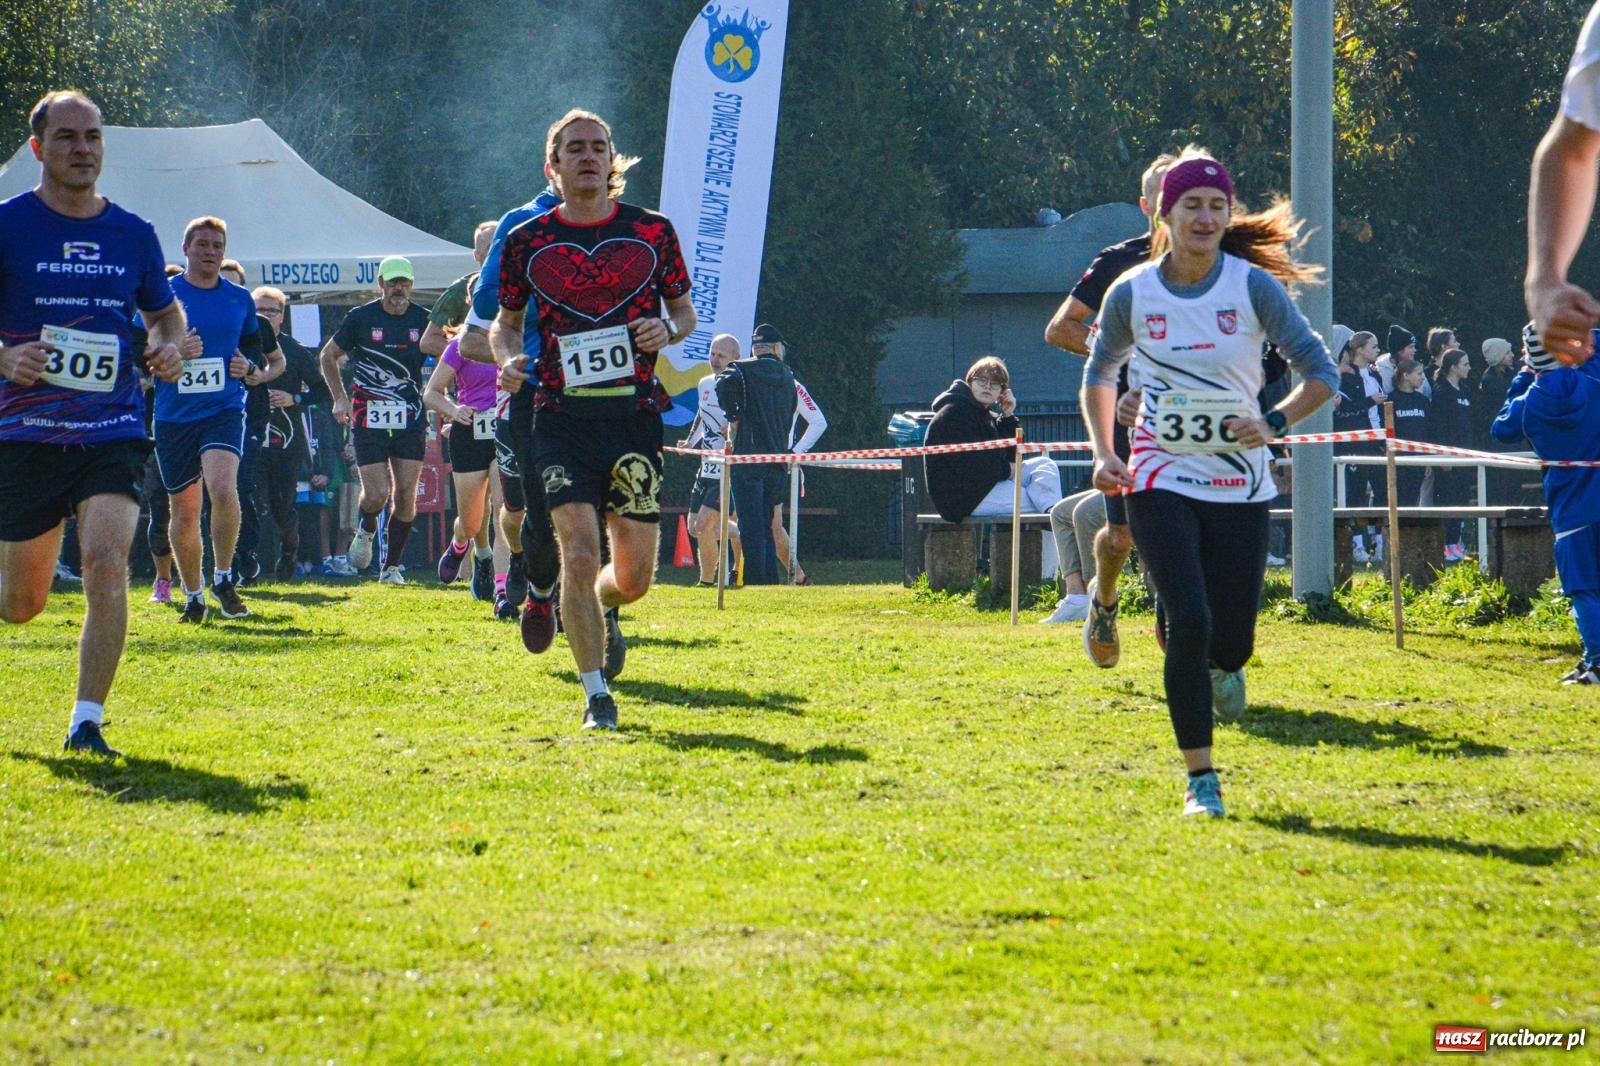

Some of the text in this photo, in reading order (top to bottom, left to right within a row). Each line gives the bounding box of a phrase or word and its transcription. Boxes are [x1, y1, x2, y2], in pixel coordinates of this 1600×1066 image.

[704, 91, 742, 187] STOWARZYSZENIE
[697, 188, 730, 239] AKTYWNI
[696, 241, 724, 263] DLA
[36, 262, 126, 276] FEROCITY
[262, 262, 339, 284] LEPSZEGO
[35, 297, 125, 307] RUNNING TEAM
[691, 266, 720, 323] LEPSZEGO
[45, 348, 115, 381] 305
[567, 345, 629, 376] 150
[182, 369, 220, 387] 341
[370, 410, 403, 424] 311
